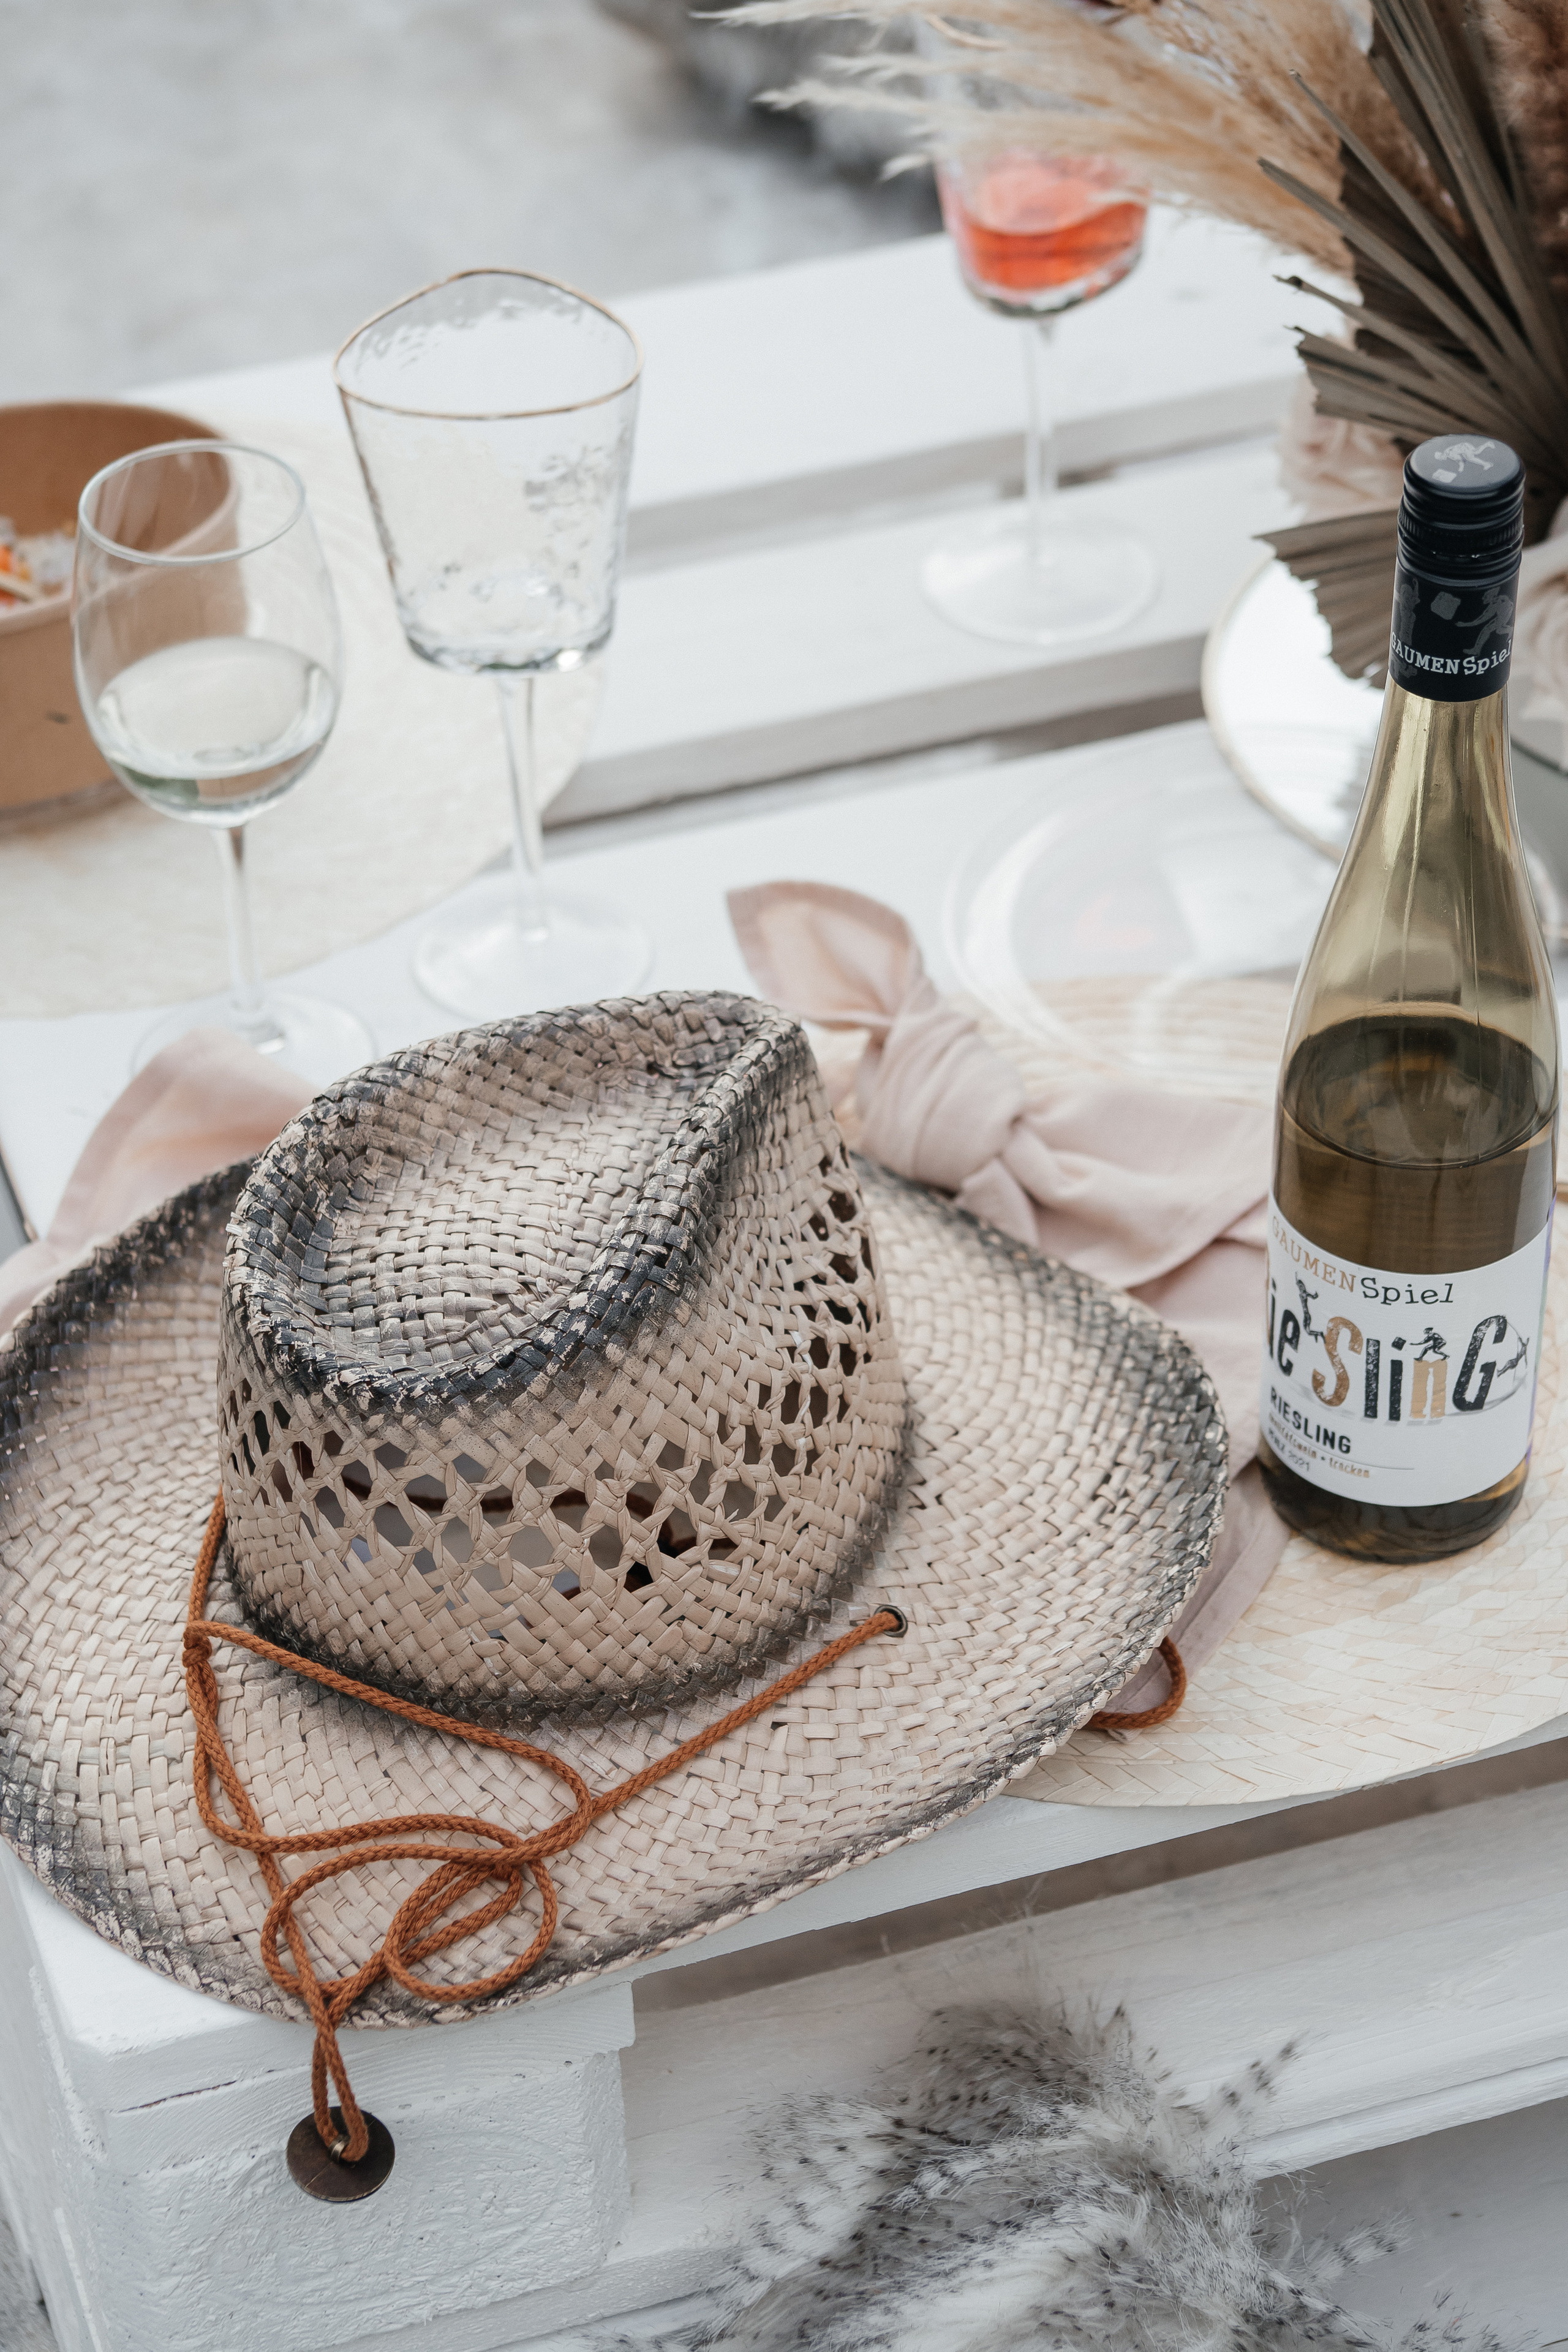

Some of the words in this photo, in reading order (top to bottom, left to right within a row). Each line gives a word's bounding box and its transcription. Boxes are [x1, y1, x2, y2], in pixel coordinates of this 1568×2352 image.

[1390, 631, 1512, 676] GAUMENSpiel
[1271, 1215, 1454, 1305] GAUMENSpiel
[1266, 1250, 1508, 1422] ieSlinG
[1270, 1385, 1352, 1454] RIESLING
[1330, 1457, 1371, 1479] trocken
